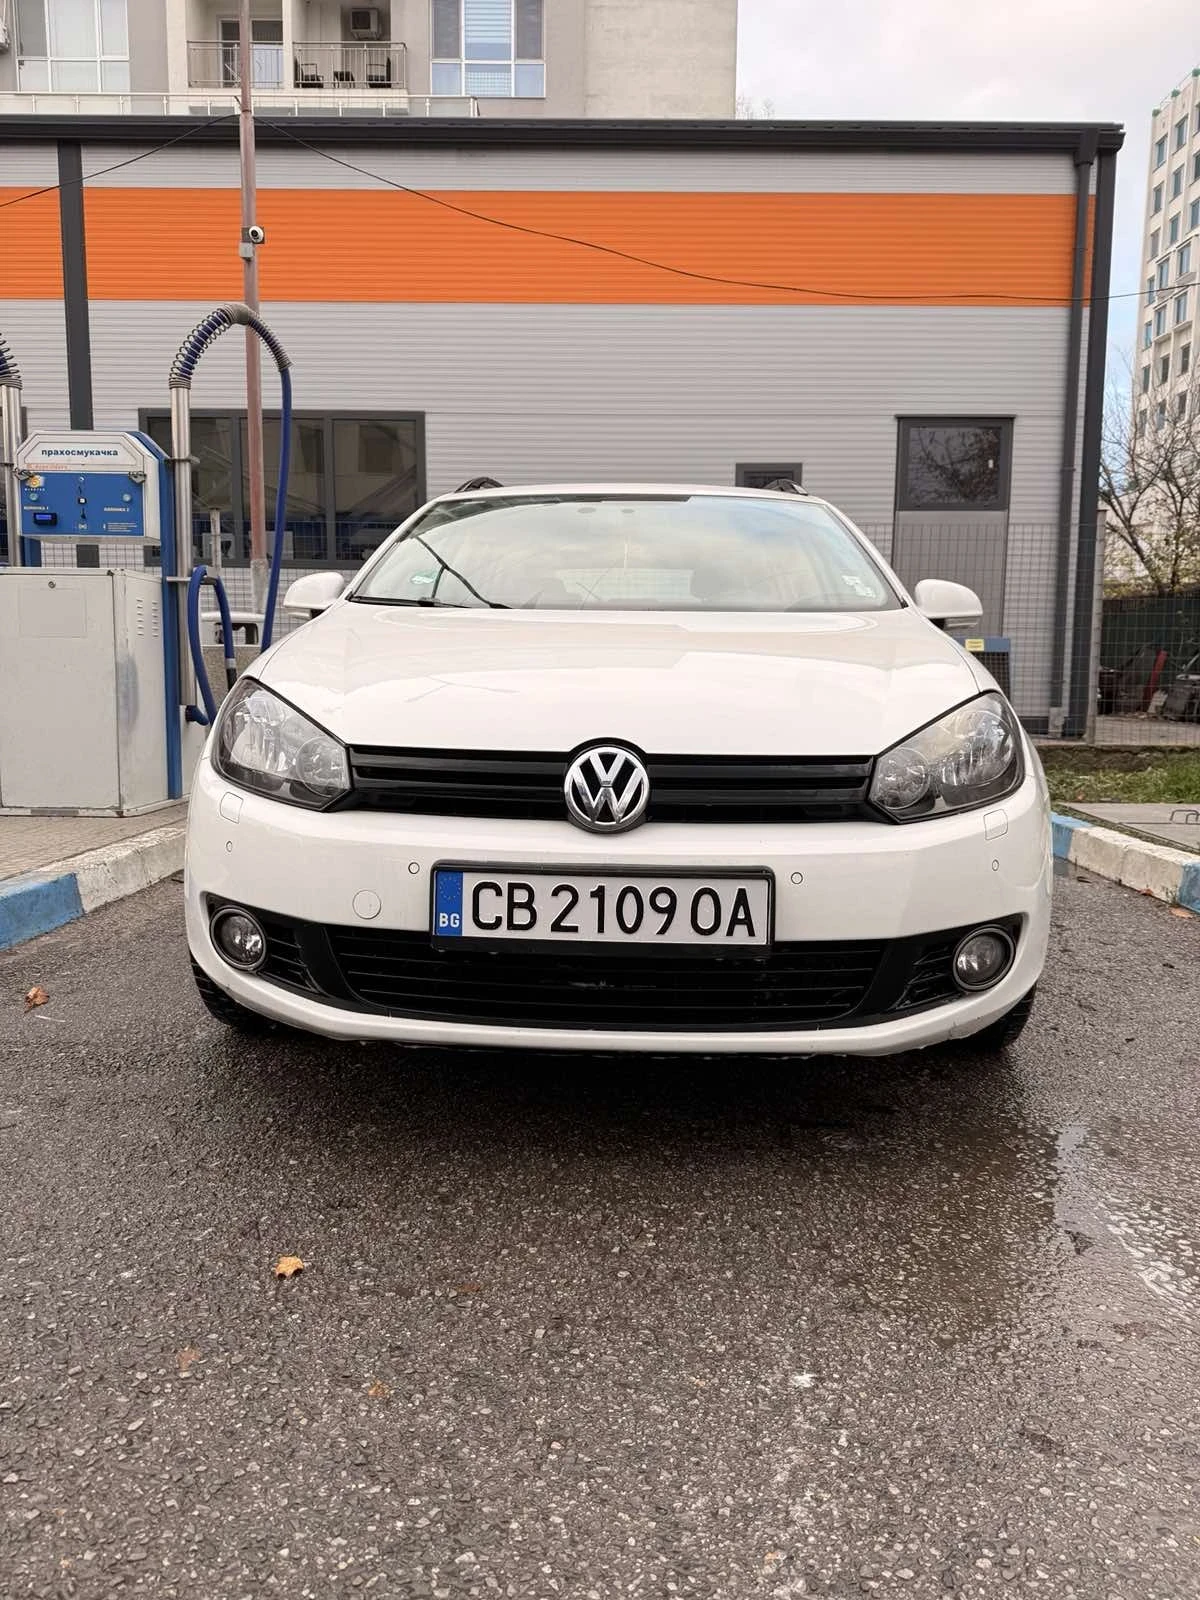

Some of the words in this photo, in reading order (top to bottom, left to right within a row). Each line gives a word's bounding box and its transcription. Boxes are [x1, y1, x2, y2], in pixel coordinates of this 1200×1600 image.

[41, 449, 118, 457] прахосмукачка
[472, 881, 537, 931] CB
[550, 883, 677, 935] 2109
[690, 886, 756, 937] OA
[439, 912, 460, 928] BG
